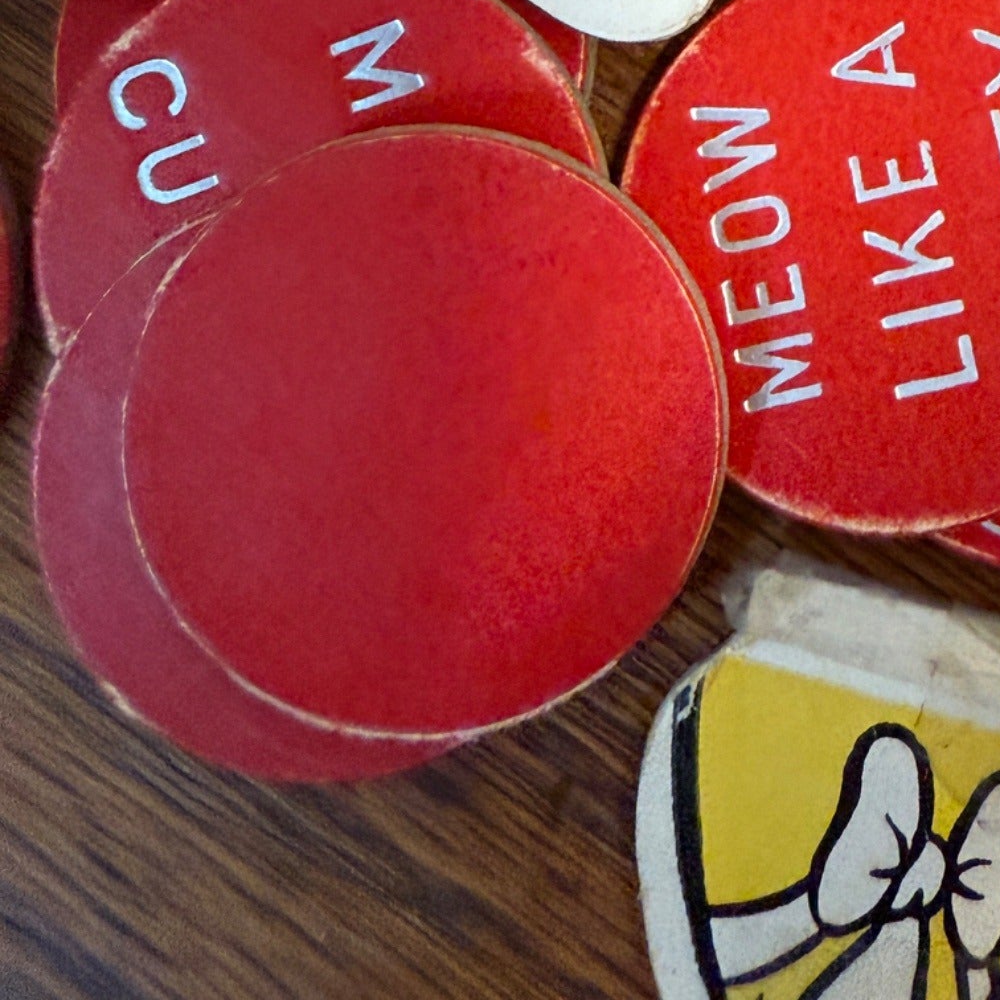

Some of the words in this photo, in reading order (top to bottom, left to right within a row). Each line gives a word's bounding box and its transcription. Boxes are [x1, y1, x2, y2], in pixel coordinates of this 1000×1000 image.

[830, 21, 916, 88] A
[690, 107, 824, 414] MEOW
[850, 140, 980, 400] LIKE
